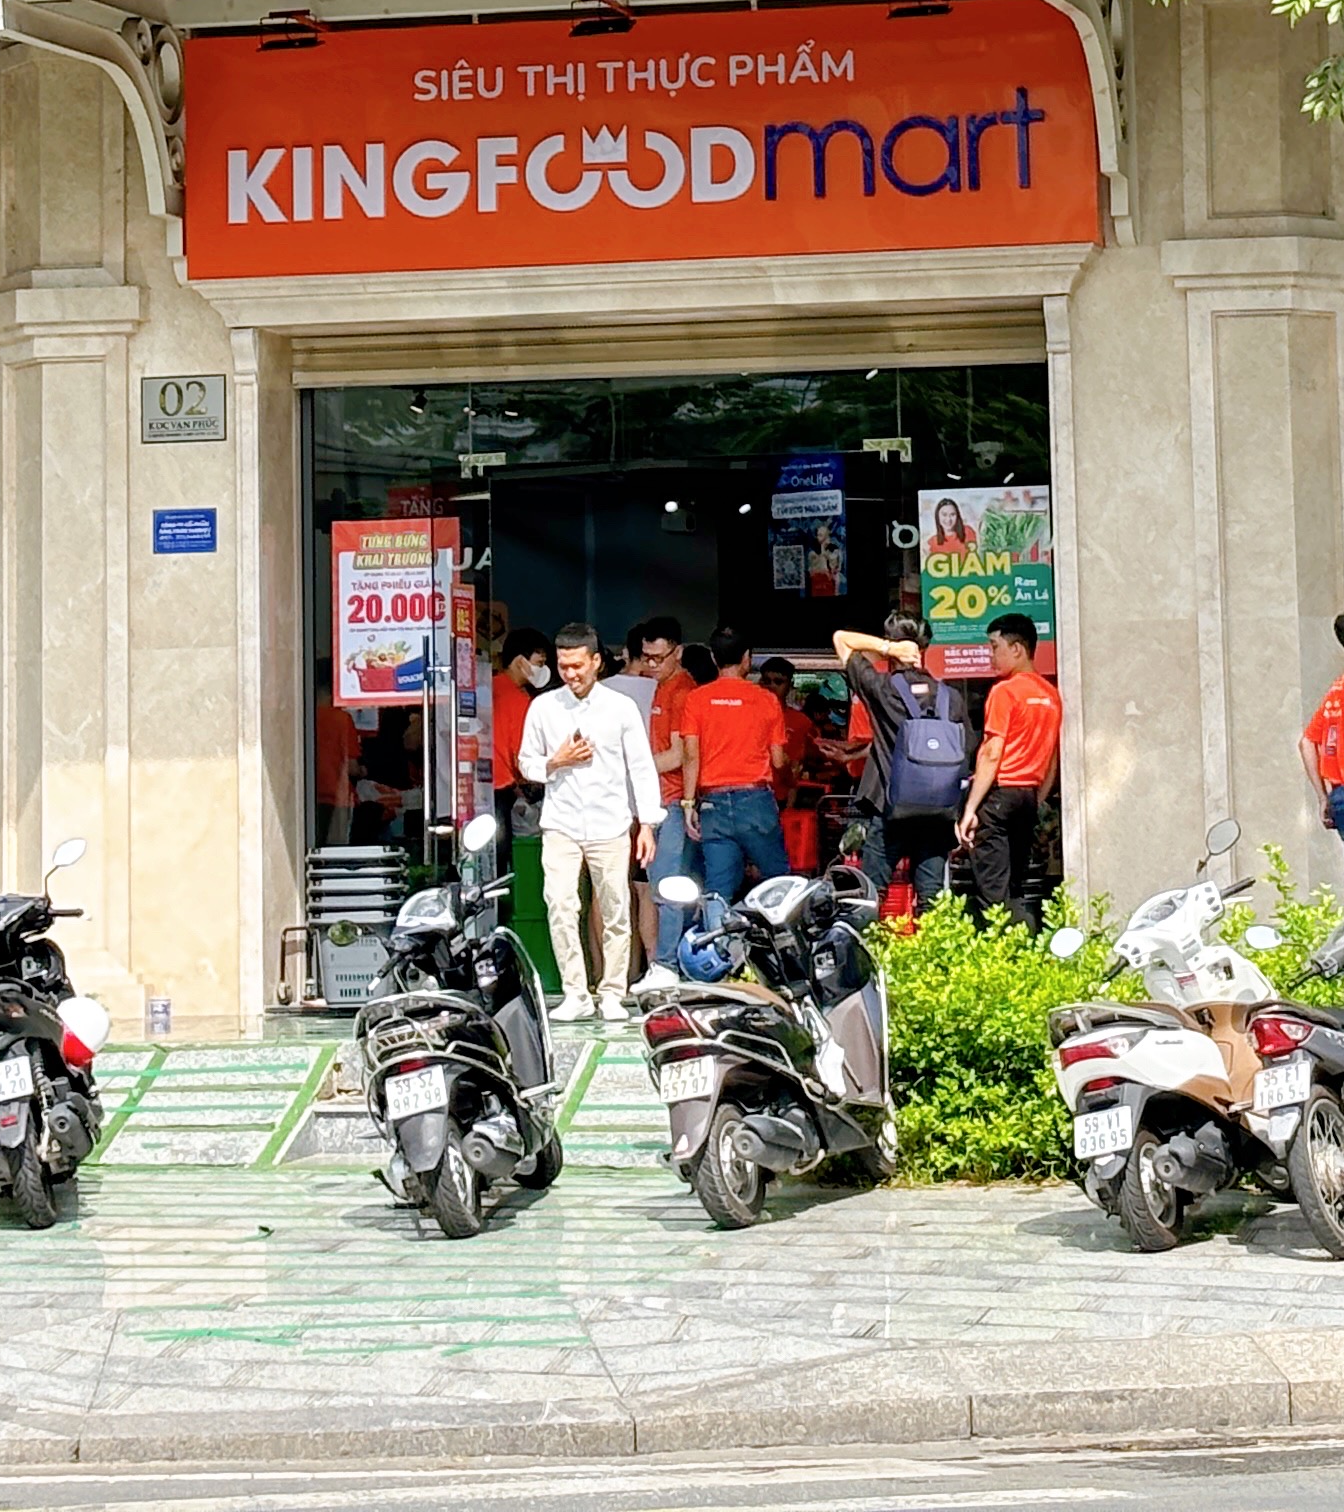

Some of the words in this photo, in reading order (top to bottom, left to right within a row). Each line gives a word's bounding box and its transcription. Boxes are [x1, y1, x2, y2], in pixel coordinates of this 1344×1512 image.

[413, 54, 511, 102] SIÊU
[517, 63, 586, 101] THỊ
[606, 56, 716, 96] THỰC
[729, 38, 856, 85] PHẨM
[159, 380, 208, 417] 02
[927, 542, 1011, 578] GIẢM
[929, 584, 1012, 619] 20%
[1015, 588, 1032, 601] Ăn
